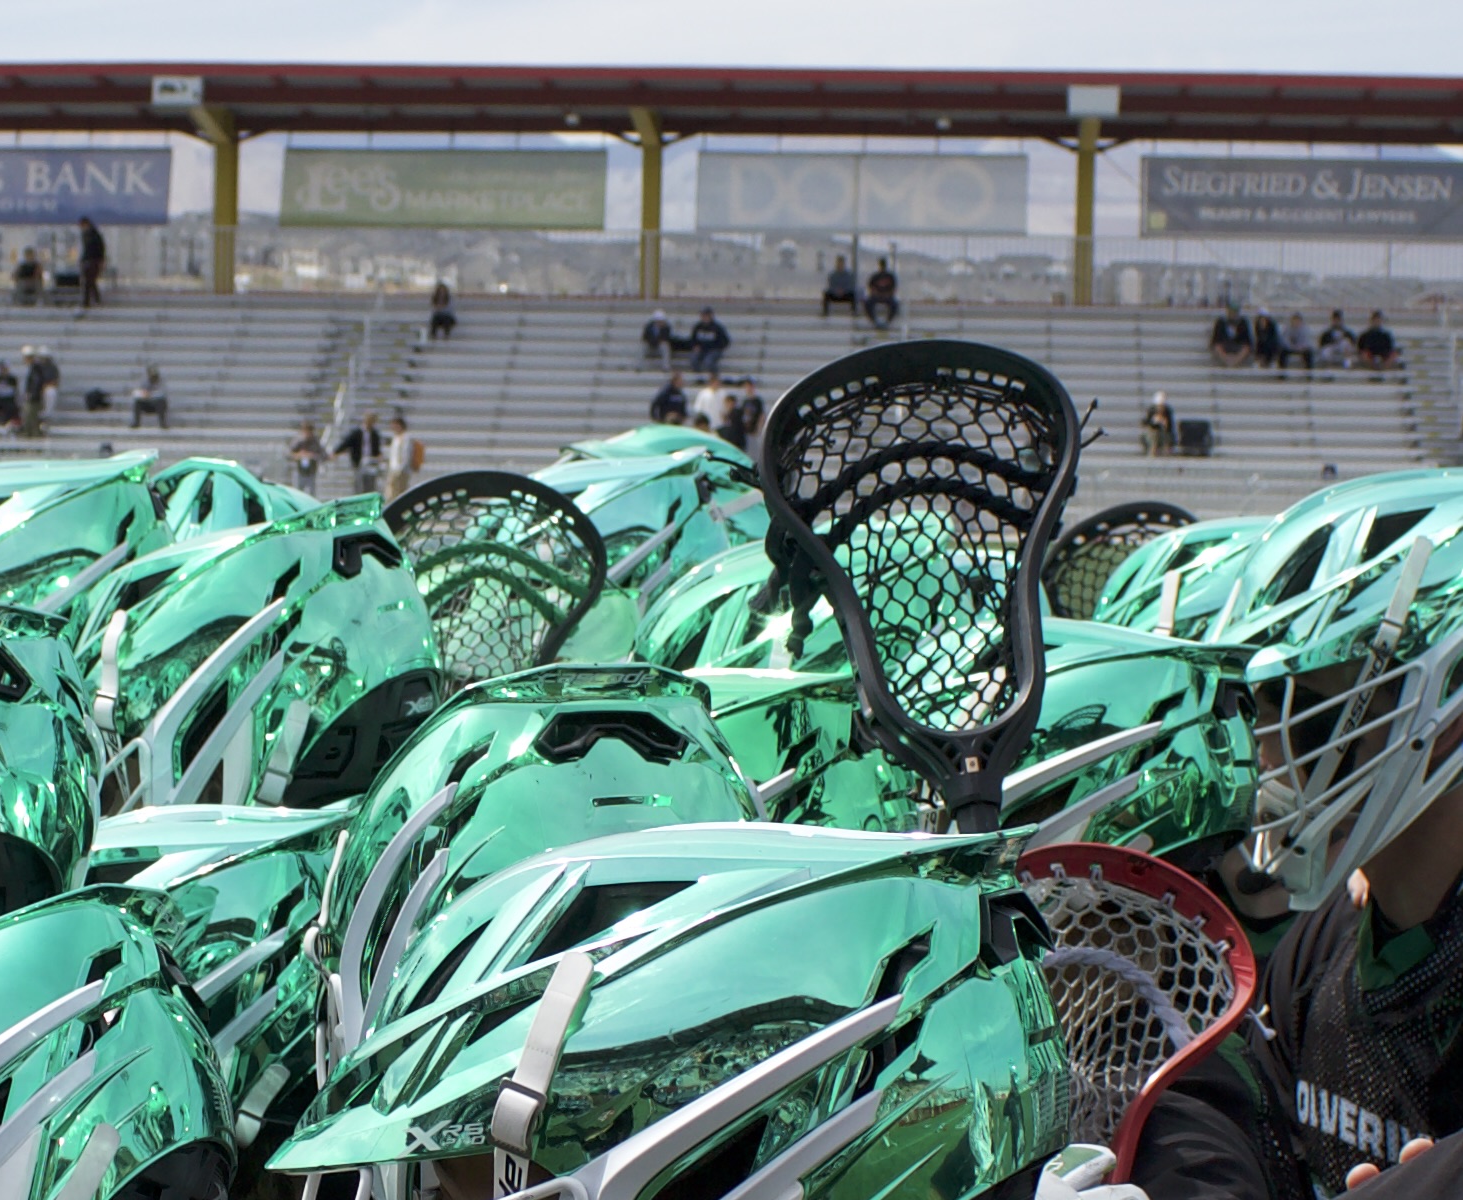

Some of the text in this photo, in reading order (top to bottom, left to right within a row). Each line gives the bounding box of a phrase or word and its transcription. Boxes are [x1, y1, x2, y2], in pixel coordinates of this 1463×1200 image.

[26, 159, 155, 197] BANK
[729, 158, 993, 226] DOMO
[1162, 165, 1454, 201] SIEGFRIED & JENSEN
